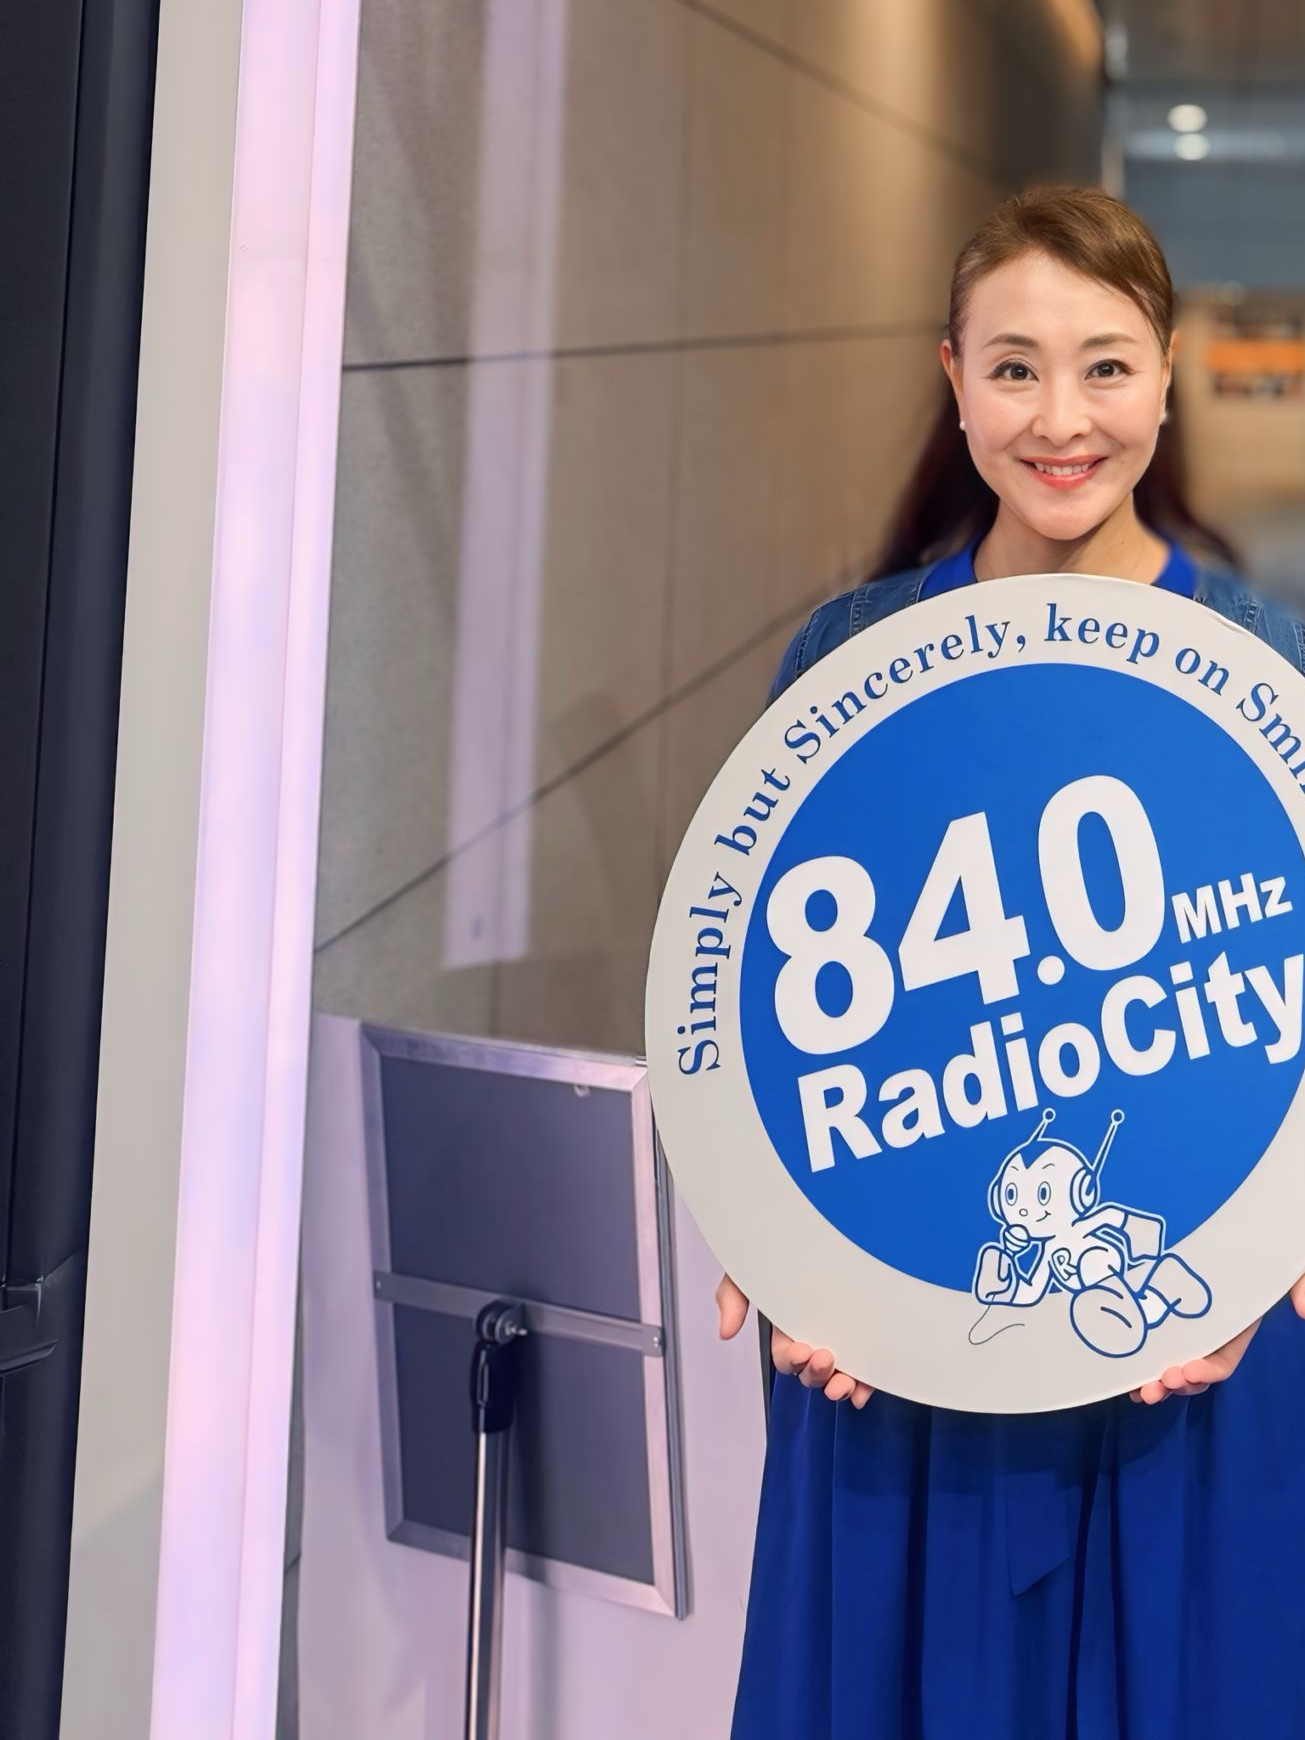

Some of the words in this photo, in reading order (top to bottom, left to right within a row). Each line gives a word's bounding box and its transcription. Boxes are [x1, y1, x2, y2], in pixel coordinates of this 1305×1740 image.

[677, 870, 744, 1077] Simply
[713, 767, 791, 858] but
[783, 614, 1028, 765] Sincerely,
[1044, 602, 1160, 663] keep
[1173, 644, 1232, 697] on
[766, 774, 1166, 1056] 84.0
[1171, 872, 1293, 944] MHz
[797, 952, 1305, 1174] RadioCity
[1051, 1247, 1078, 1281] R
